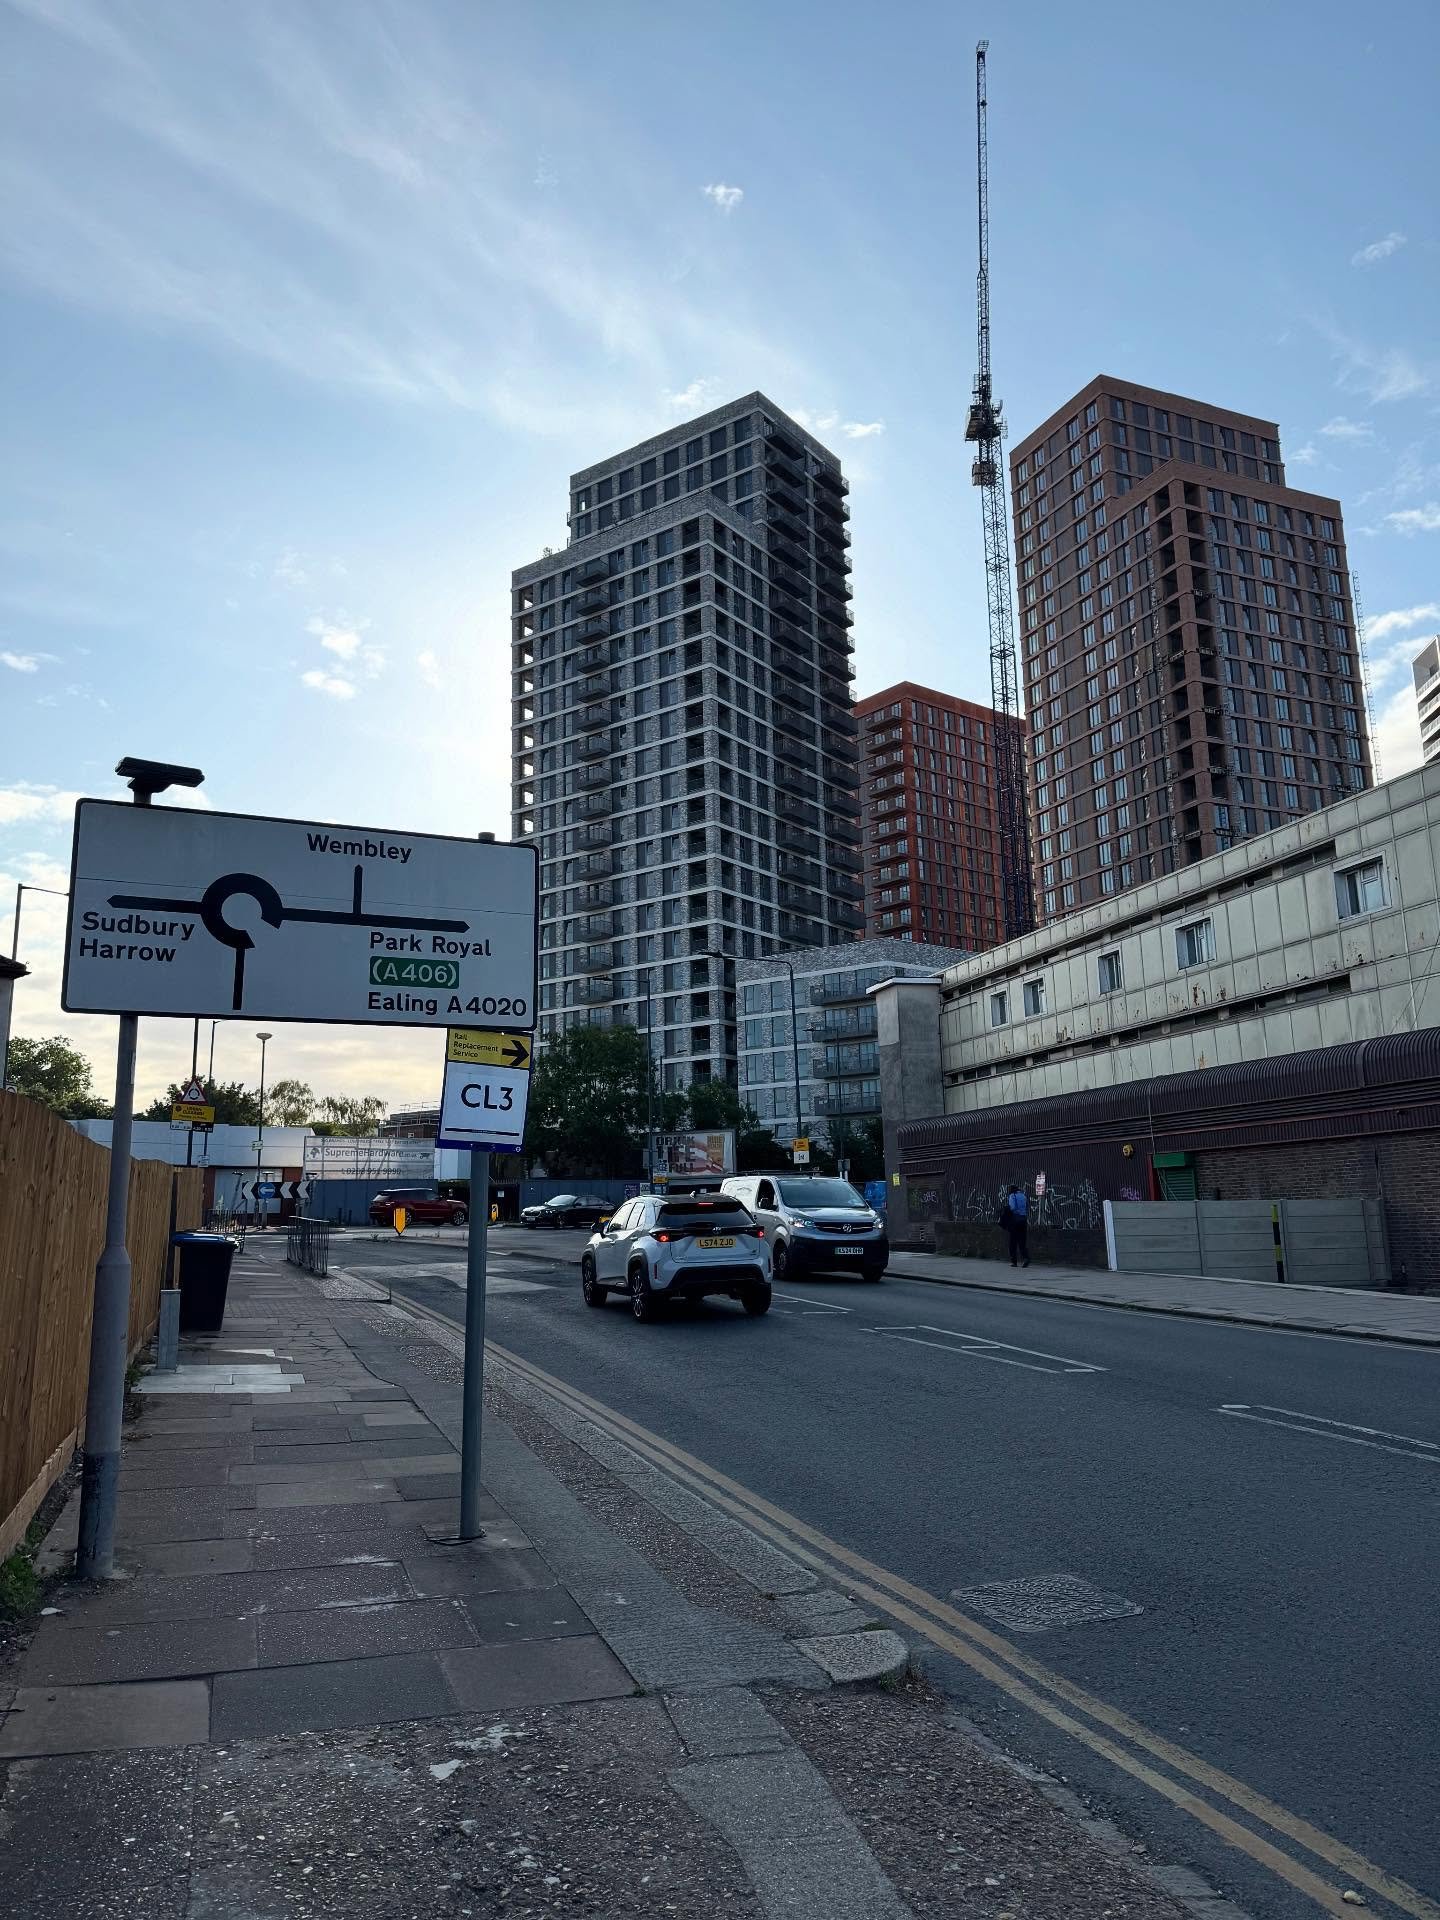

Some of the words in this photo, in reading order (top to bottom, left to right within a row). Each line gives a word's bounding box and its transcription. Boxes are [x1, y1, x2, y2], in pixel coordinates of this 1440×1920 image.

[307, 833, 412, 863] Wembley
[82, 911, 195, 941] Sudbury
[79, 938, 177, 962] Harrow
[370, 932, 422, 953] Park
[431, 935, 492, 957] Royal
[371, 957, 458, 987] (A406)
[367, 992, 438, 1016] Ealing
[447, 996, 527, 1017] A4020
[452, 1049, 479, 1058] Service
[453, 1041, 499, 1052] Replacement
[460, 1083, 514, 1112] CL3
[699, 1239, 718, 1247] LS74
